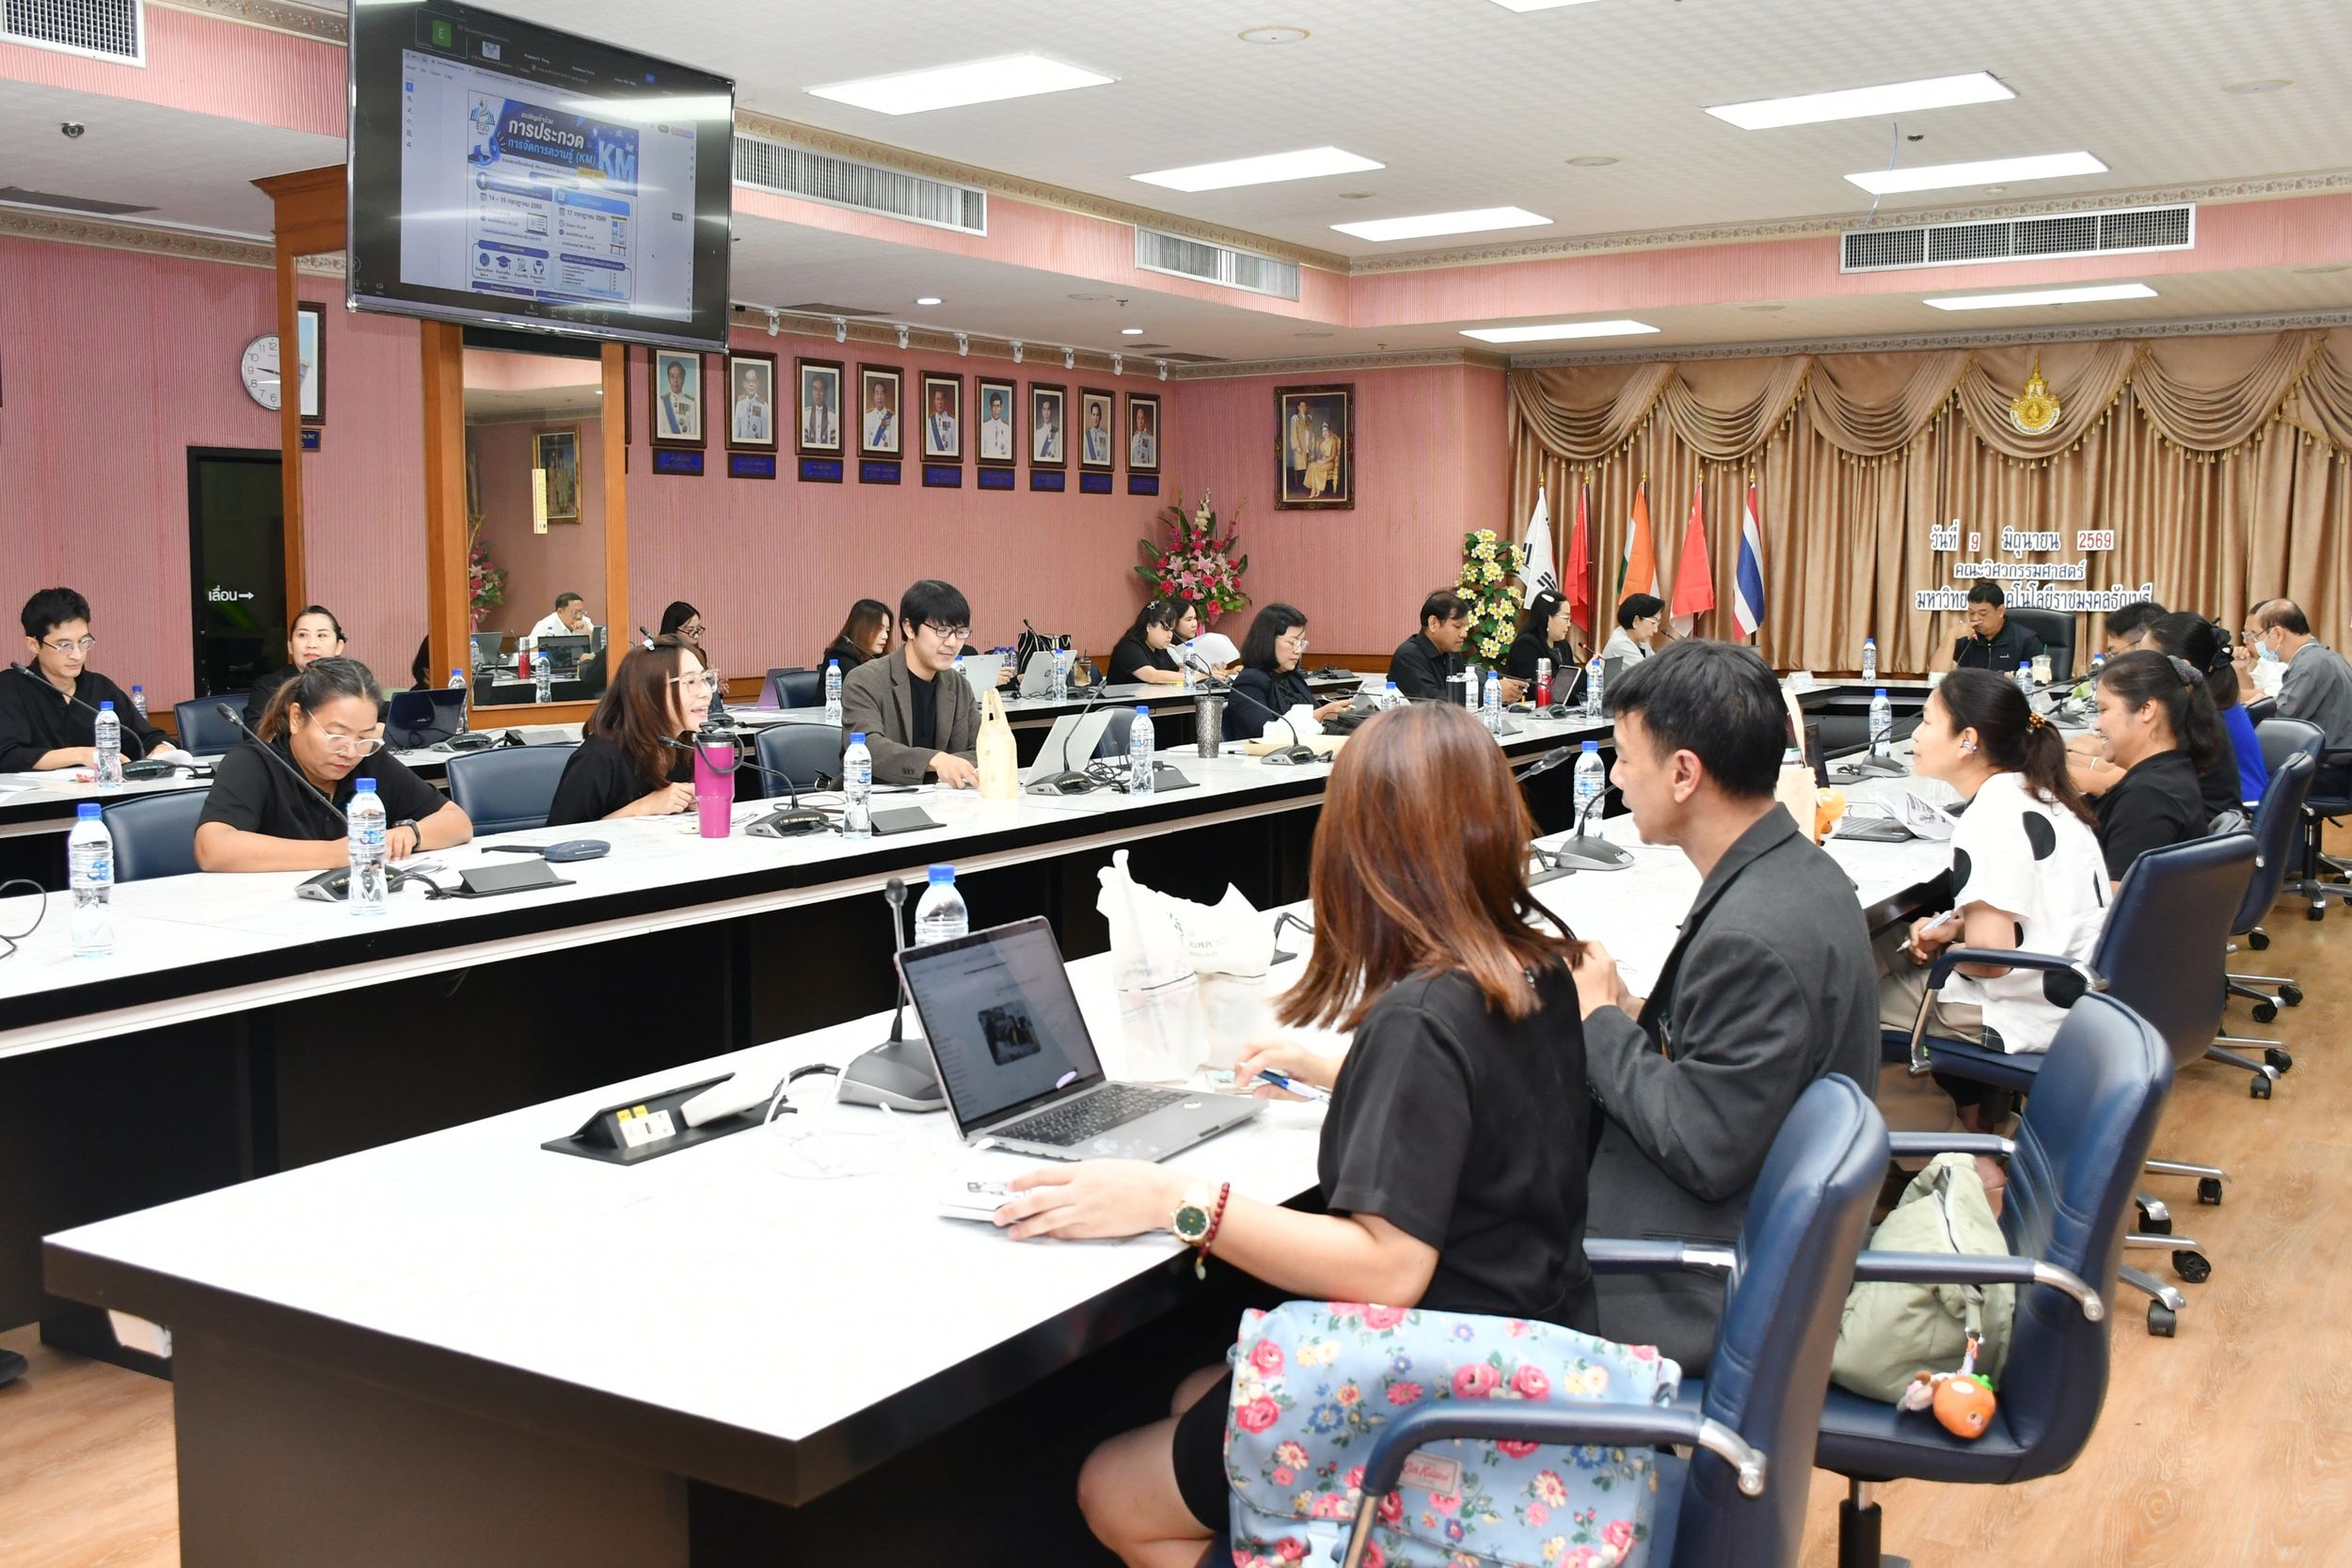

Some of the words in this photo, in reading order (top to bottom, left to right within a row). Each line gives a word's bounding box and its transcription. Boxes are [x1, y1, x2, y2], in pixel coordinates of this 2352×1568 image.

[438, 28, 445, 40] E
[508, 119, 584, 150] การประกวด
[508, 138, 574, 165] การจัดการความรู้
[576, 153, 596, 166] (KM)
[597, 140, 636, 186] KM
[259, 344, 265, 353] 11
[268, 341, 278, 351] 12
[247, 353, 260, 363] 10
[247, 366, 254, 375] 9
[250, 379, 258, 388] 8
[259, 388, 265, 398] 7
[270, 393, 278, 403] 6
[1931, 520, 1958, 549] วันที่
[1971, 532, 1979, 549] 9
[2002, 527, 2060, 557] มิถุนายน
[2078, 532, 2112, 548] 2569
[1955, 560, 2086, 578] คณะวิศวกรรมศาสตร์
[208, 585, 238, 602] เลื่อน
